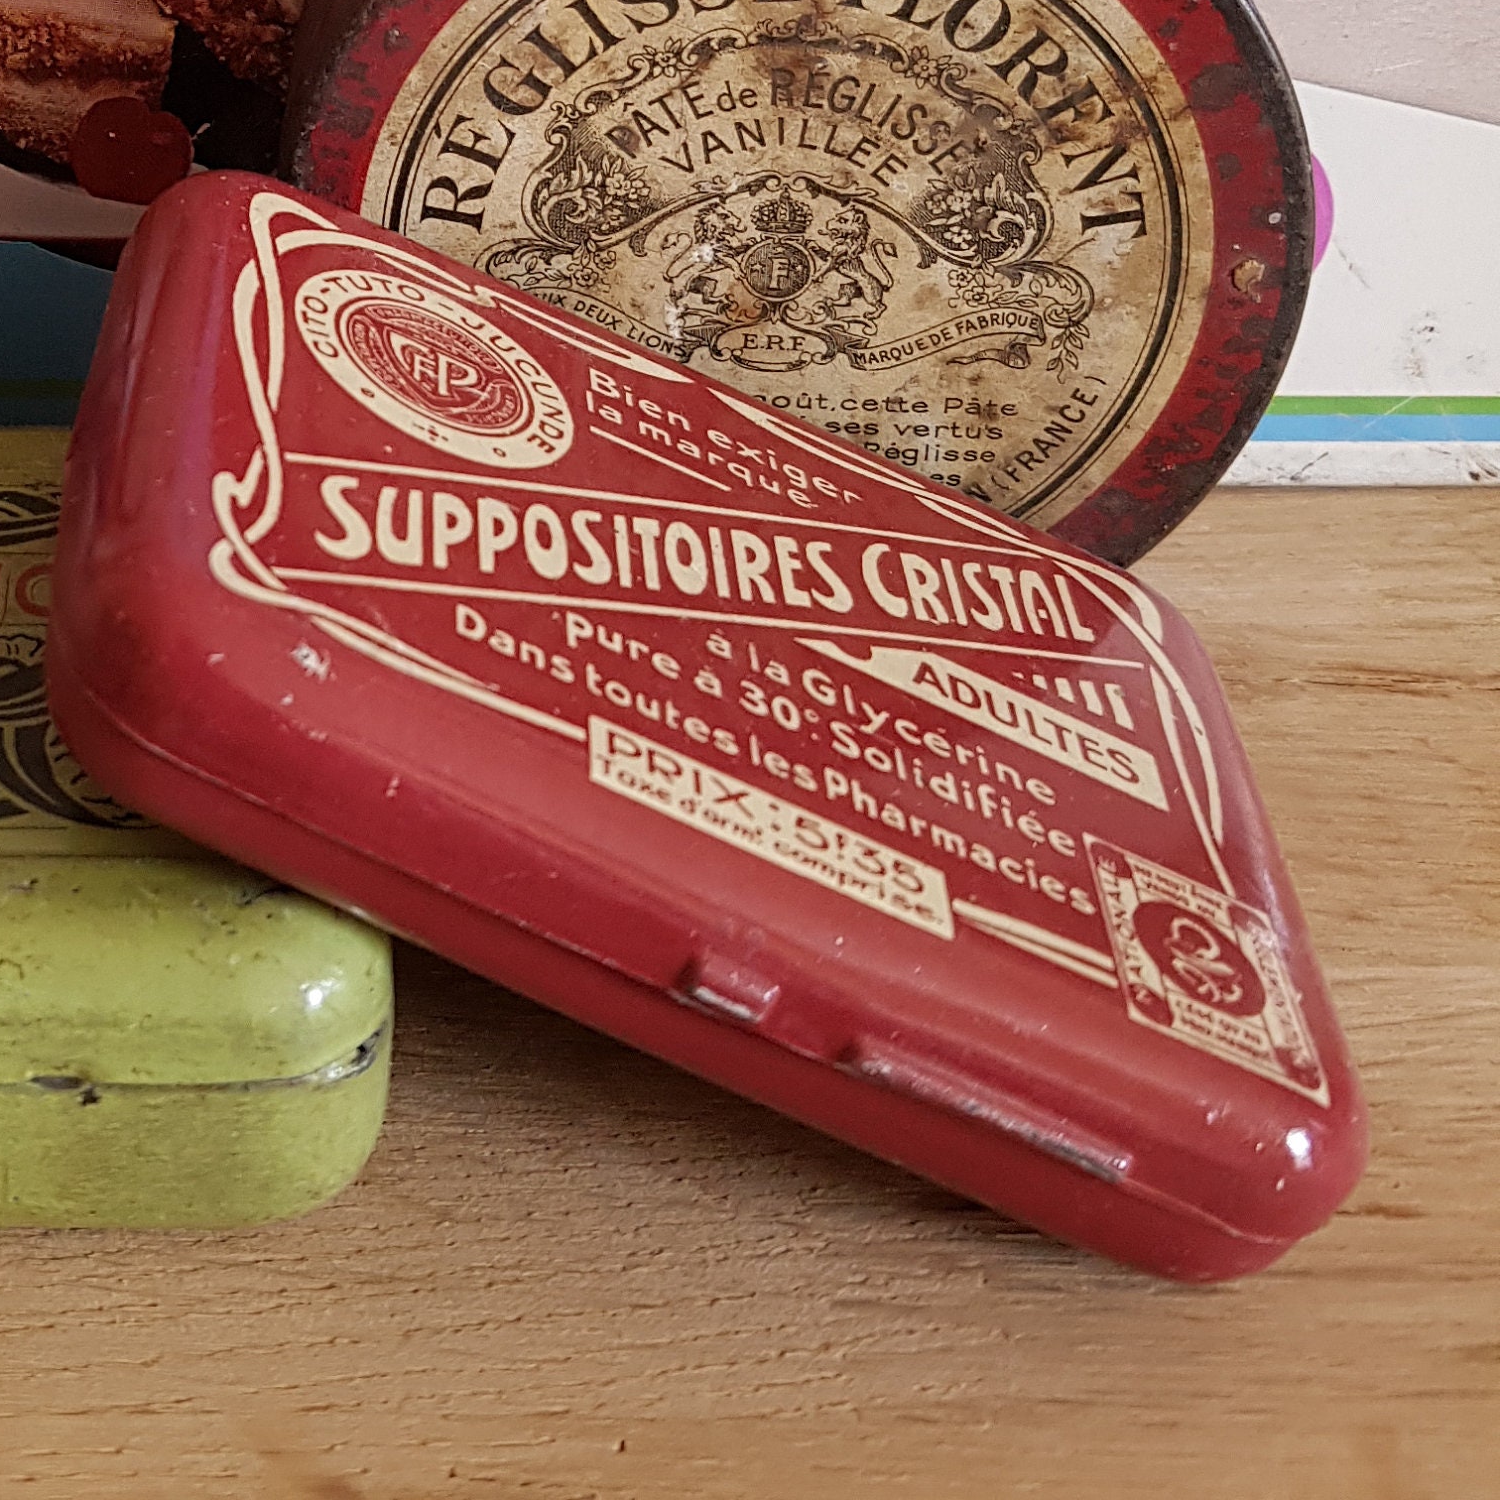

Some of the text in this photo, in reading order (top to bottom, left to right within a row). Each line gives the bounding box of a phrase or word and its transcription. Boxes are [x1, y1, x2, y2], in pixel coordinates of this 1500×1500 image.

[605, 62, 972, 177] PÂTE de RÉGLISSE
[574, 300, 623, 332] DEUX
[851, 311, 1042, 366] MARQUE DE FABRIQUE
[585, 389, 623, 426] la
[588, 367, 692, 432] Bien
[706, 428, 864, 505] exiger
[824, 419, 1004, 441] ses vertus
[839, 396, 930, 414] cette
[943, 395, 1019, 418] Pâte
[314, 475, 1096, 644] SUPPOSITOIRES CRISTAL
[455, 602, 577, 684] Dans
[585, 662, 740, 756] toutes
[749, 733, 819, 792] les
[823, 765, 1098, 916] Pharmacies
[692, 663, 724, 699] à
[829, 720, 1077, 858] Solidifiée
[705, 627, 1058, 807] à la Glycérine
[912, 661, 1142, 785] ADULTES
